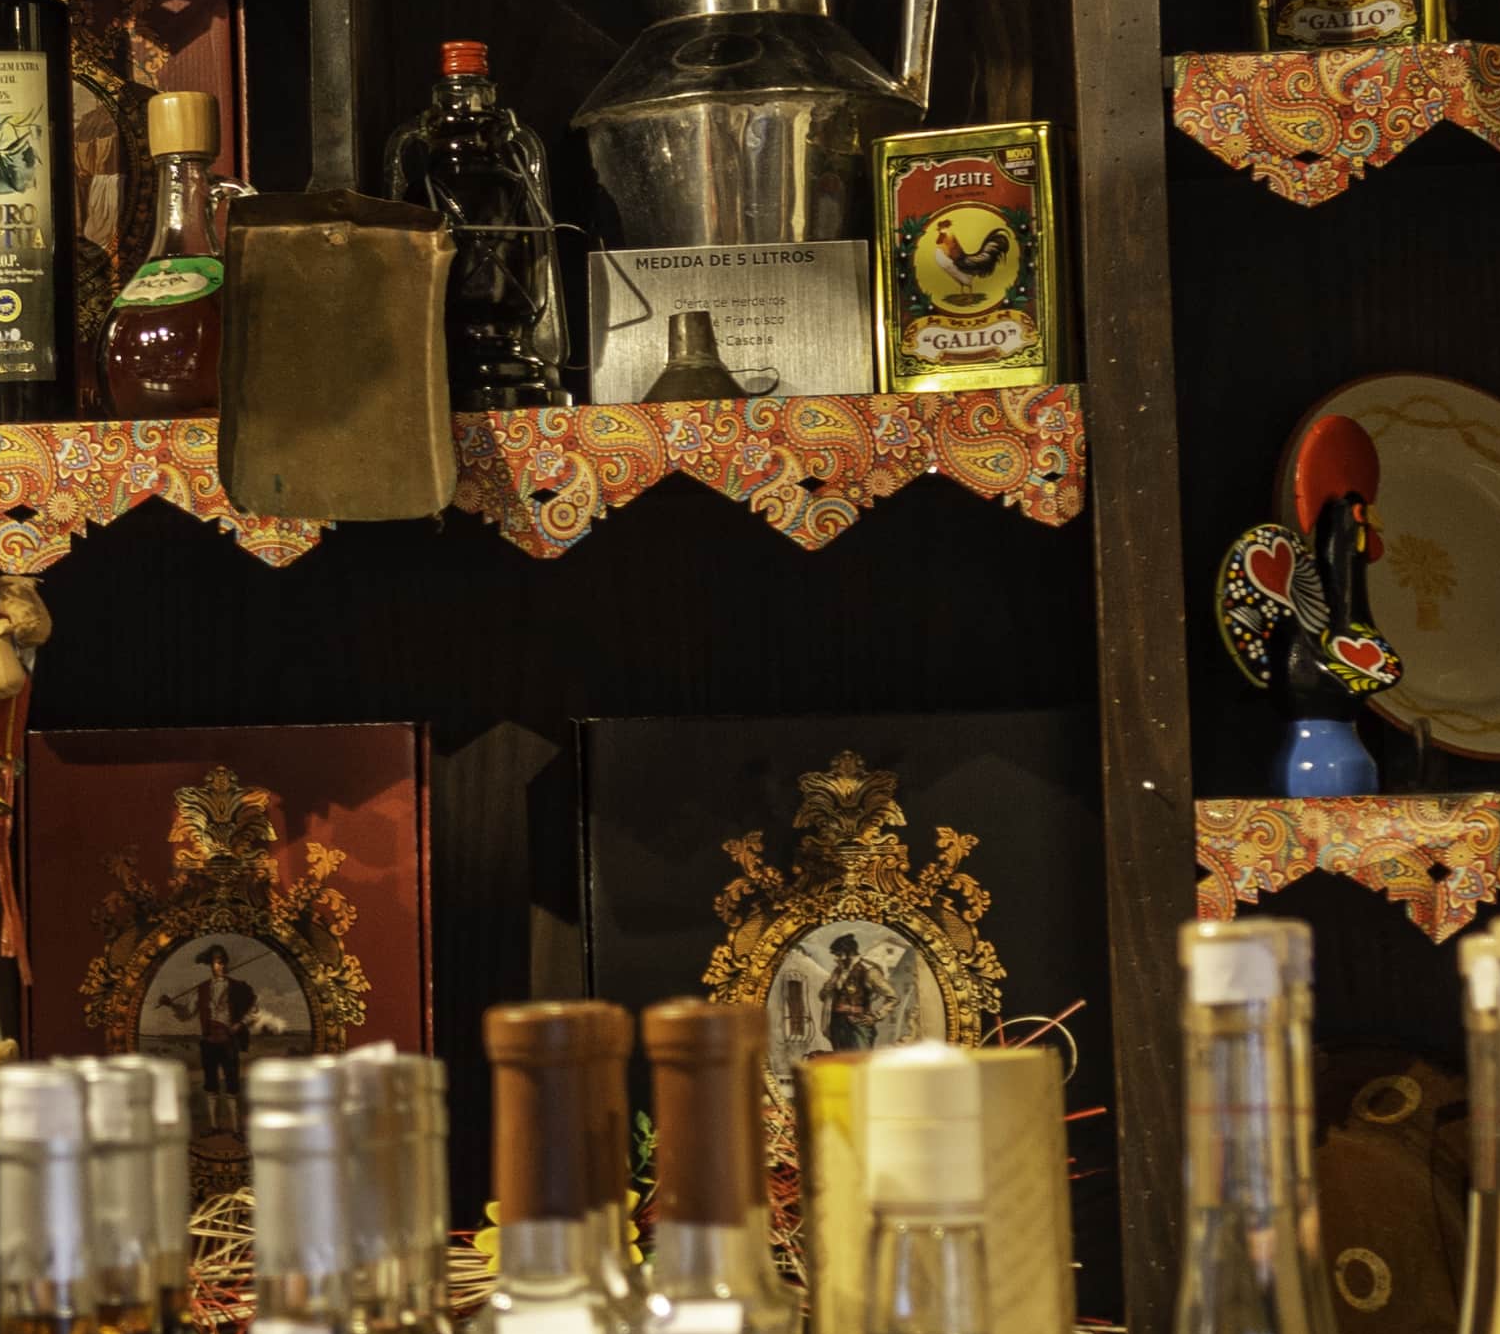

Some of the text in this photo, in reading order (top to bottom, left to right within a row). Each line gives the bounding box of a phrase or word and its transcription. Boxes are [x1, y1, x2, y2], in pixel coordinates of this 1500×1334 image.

[933, 171, 994, 192] AZEITE
[0, 226, 46, 251] TUA
[635, 250, 816, 270] MEDIDA DE 5 LITROS
[731, 295, 787, 308] Herdeiros
[724, 315, 786, 326] Francisco
